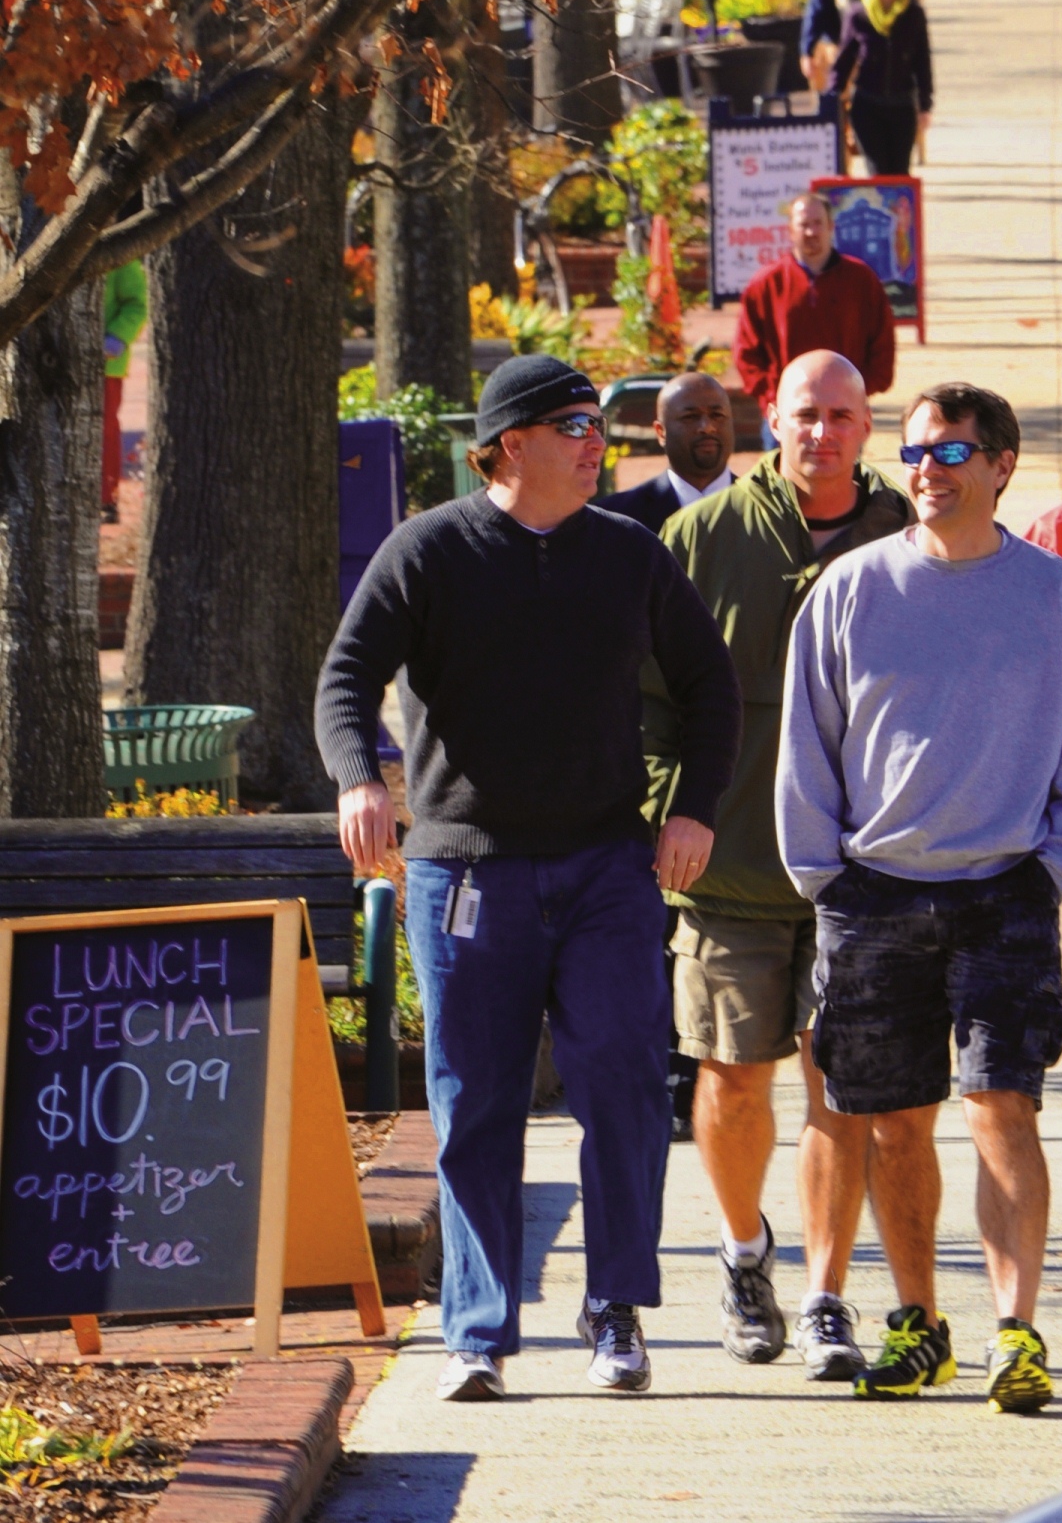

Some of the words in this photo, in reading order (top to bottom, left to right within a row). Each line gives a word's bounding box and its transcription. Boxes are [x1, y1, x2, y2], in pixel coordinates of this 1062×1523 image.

[729, 144, 763, 155] Watch
[769, 139, 819, 152] Batteries
[740, 187, 779, 199] Highest
[53, 938, 228, 999] LUNCH
[24, 994, 260, 1056] SPECIAL
[37, 1058, 231, 1151] $10.99
[14, 1152, 244, 1221] appetizer
[48, 1231, 200, 1273] entree
